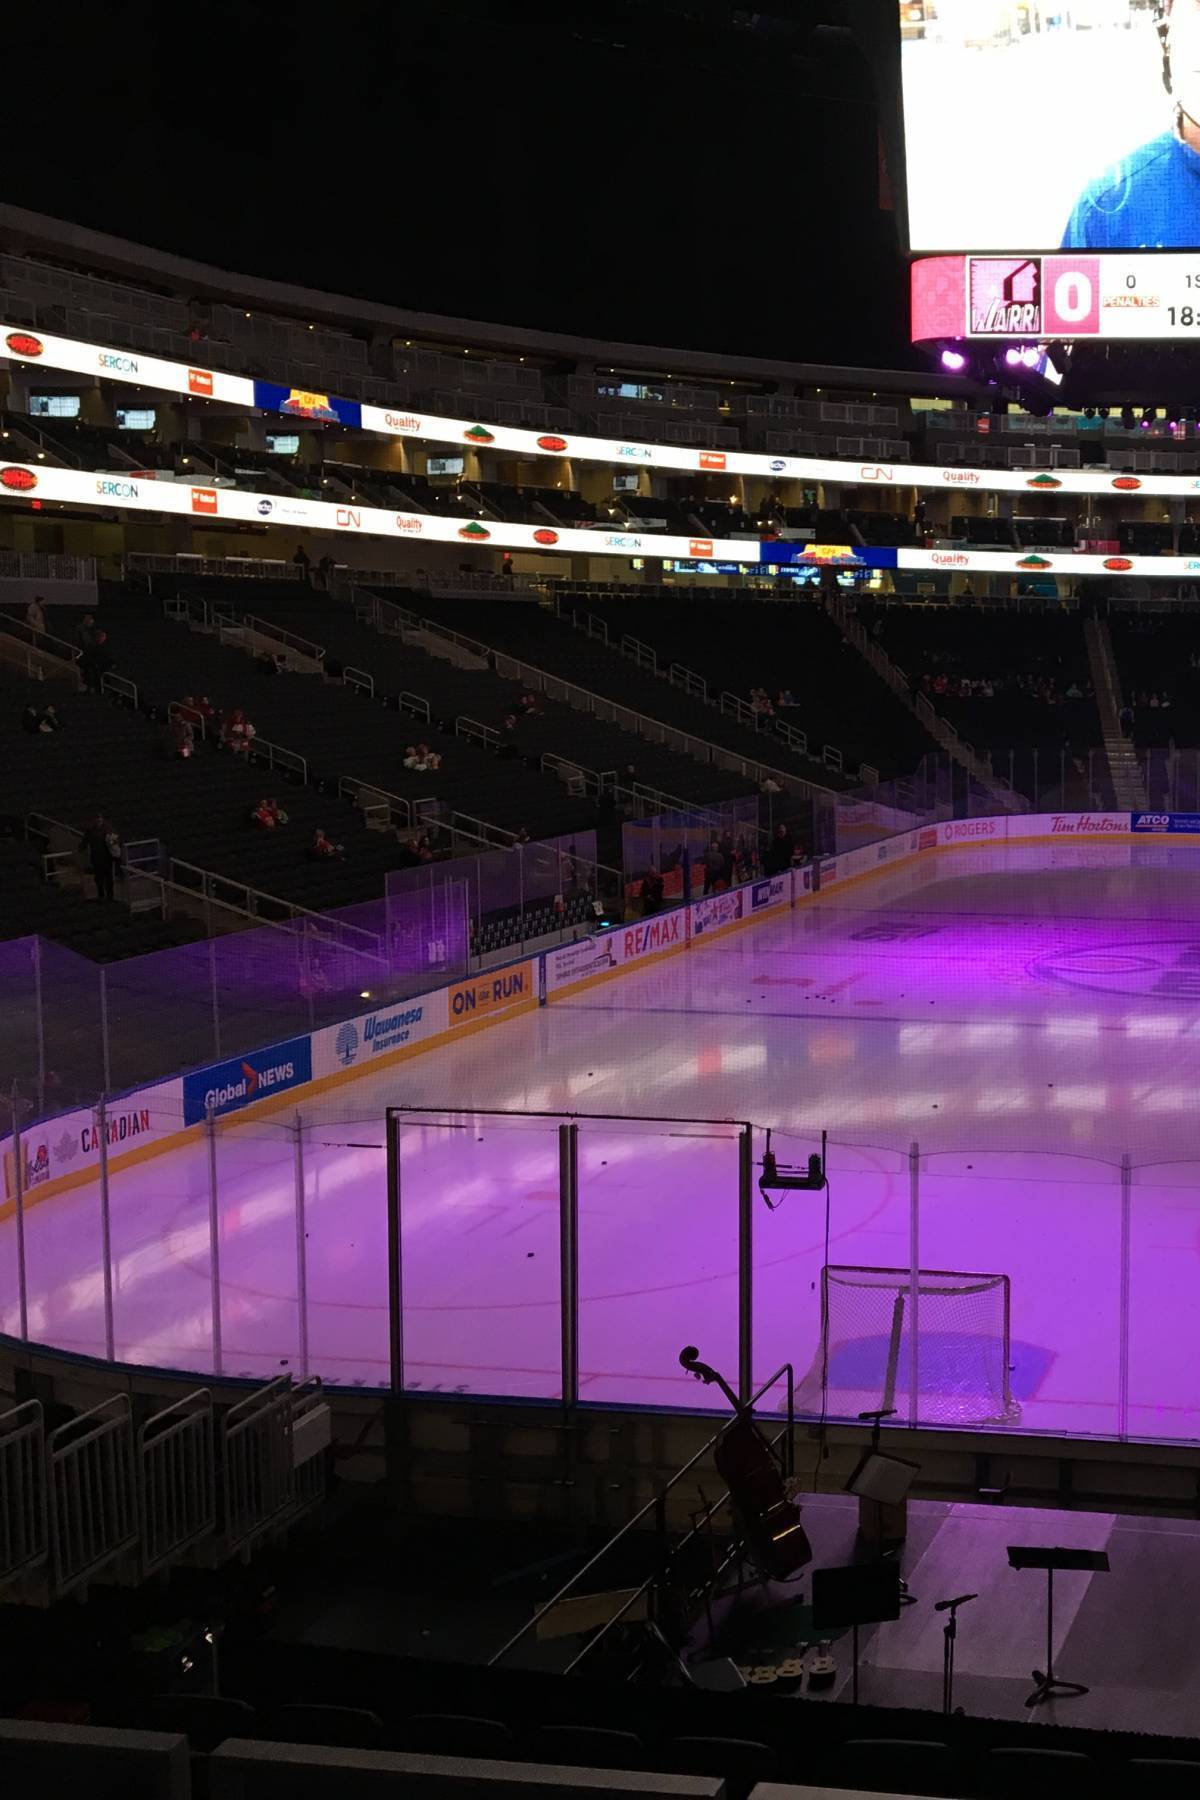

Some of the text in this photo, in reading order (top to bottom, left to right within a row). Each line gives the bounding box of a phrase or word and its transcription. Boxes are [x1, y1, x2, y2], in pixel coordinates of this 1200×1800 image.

[1126, 275, 1137, 289] 0
[1054, 272, 1092, 321] 0
[98, 354, 138, 374] SERCON
[385, 413, 422, 432] Quality
[942, 470, 980, 483] Quality
[97, 480, 139, 498] SERCON
[396, 516, 423, 532] Quality
[931, 553, 970, 566] Quality
[1051, 816, 1129, 832] Tim Hortons
[1136, 815, 1170, 825] ATCO
[954, 821, 995, 839] ROGERS
[624, 916, 679, 958] RE/MAX
[452, 987, 477, 1015] ON
[363, 1006, 424, 1041] Wawanesa
[372, 1029, 410, 1052] Insurance
[204, 1062, 294, 1110] Global NEWS
